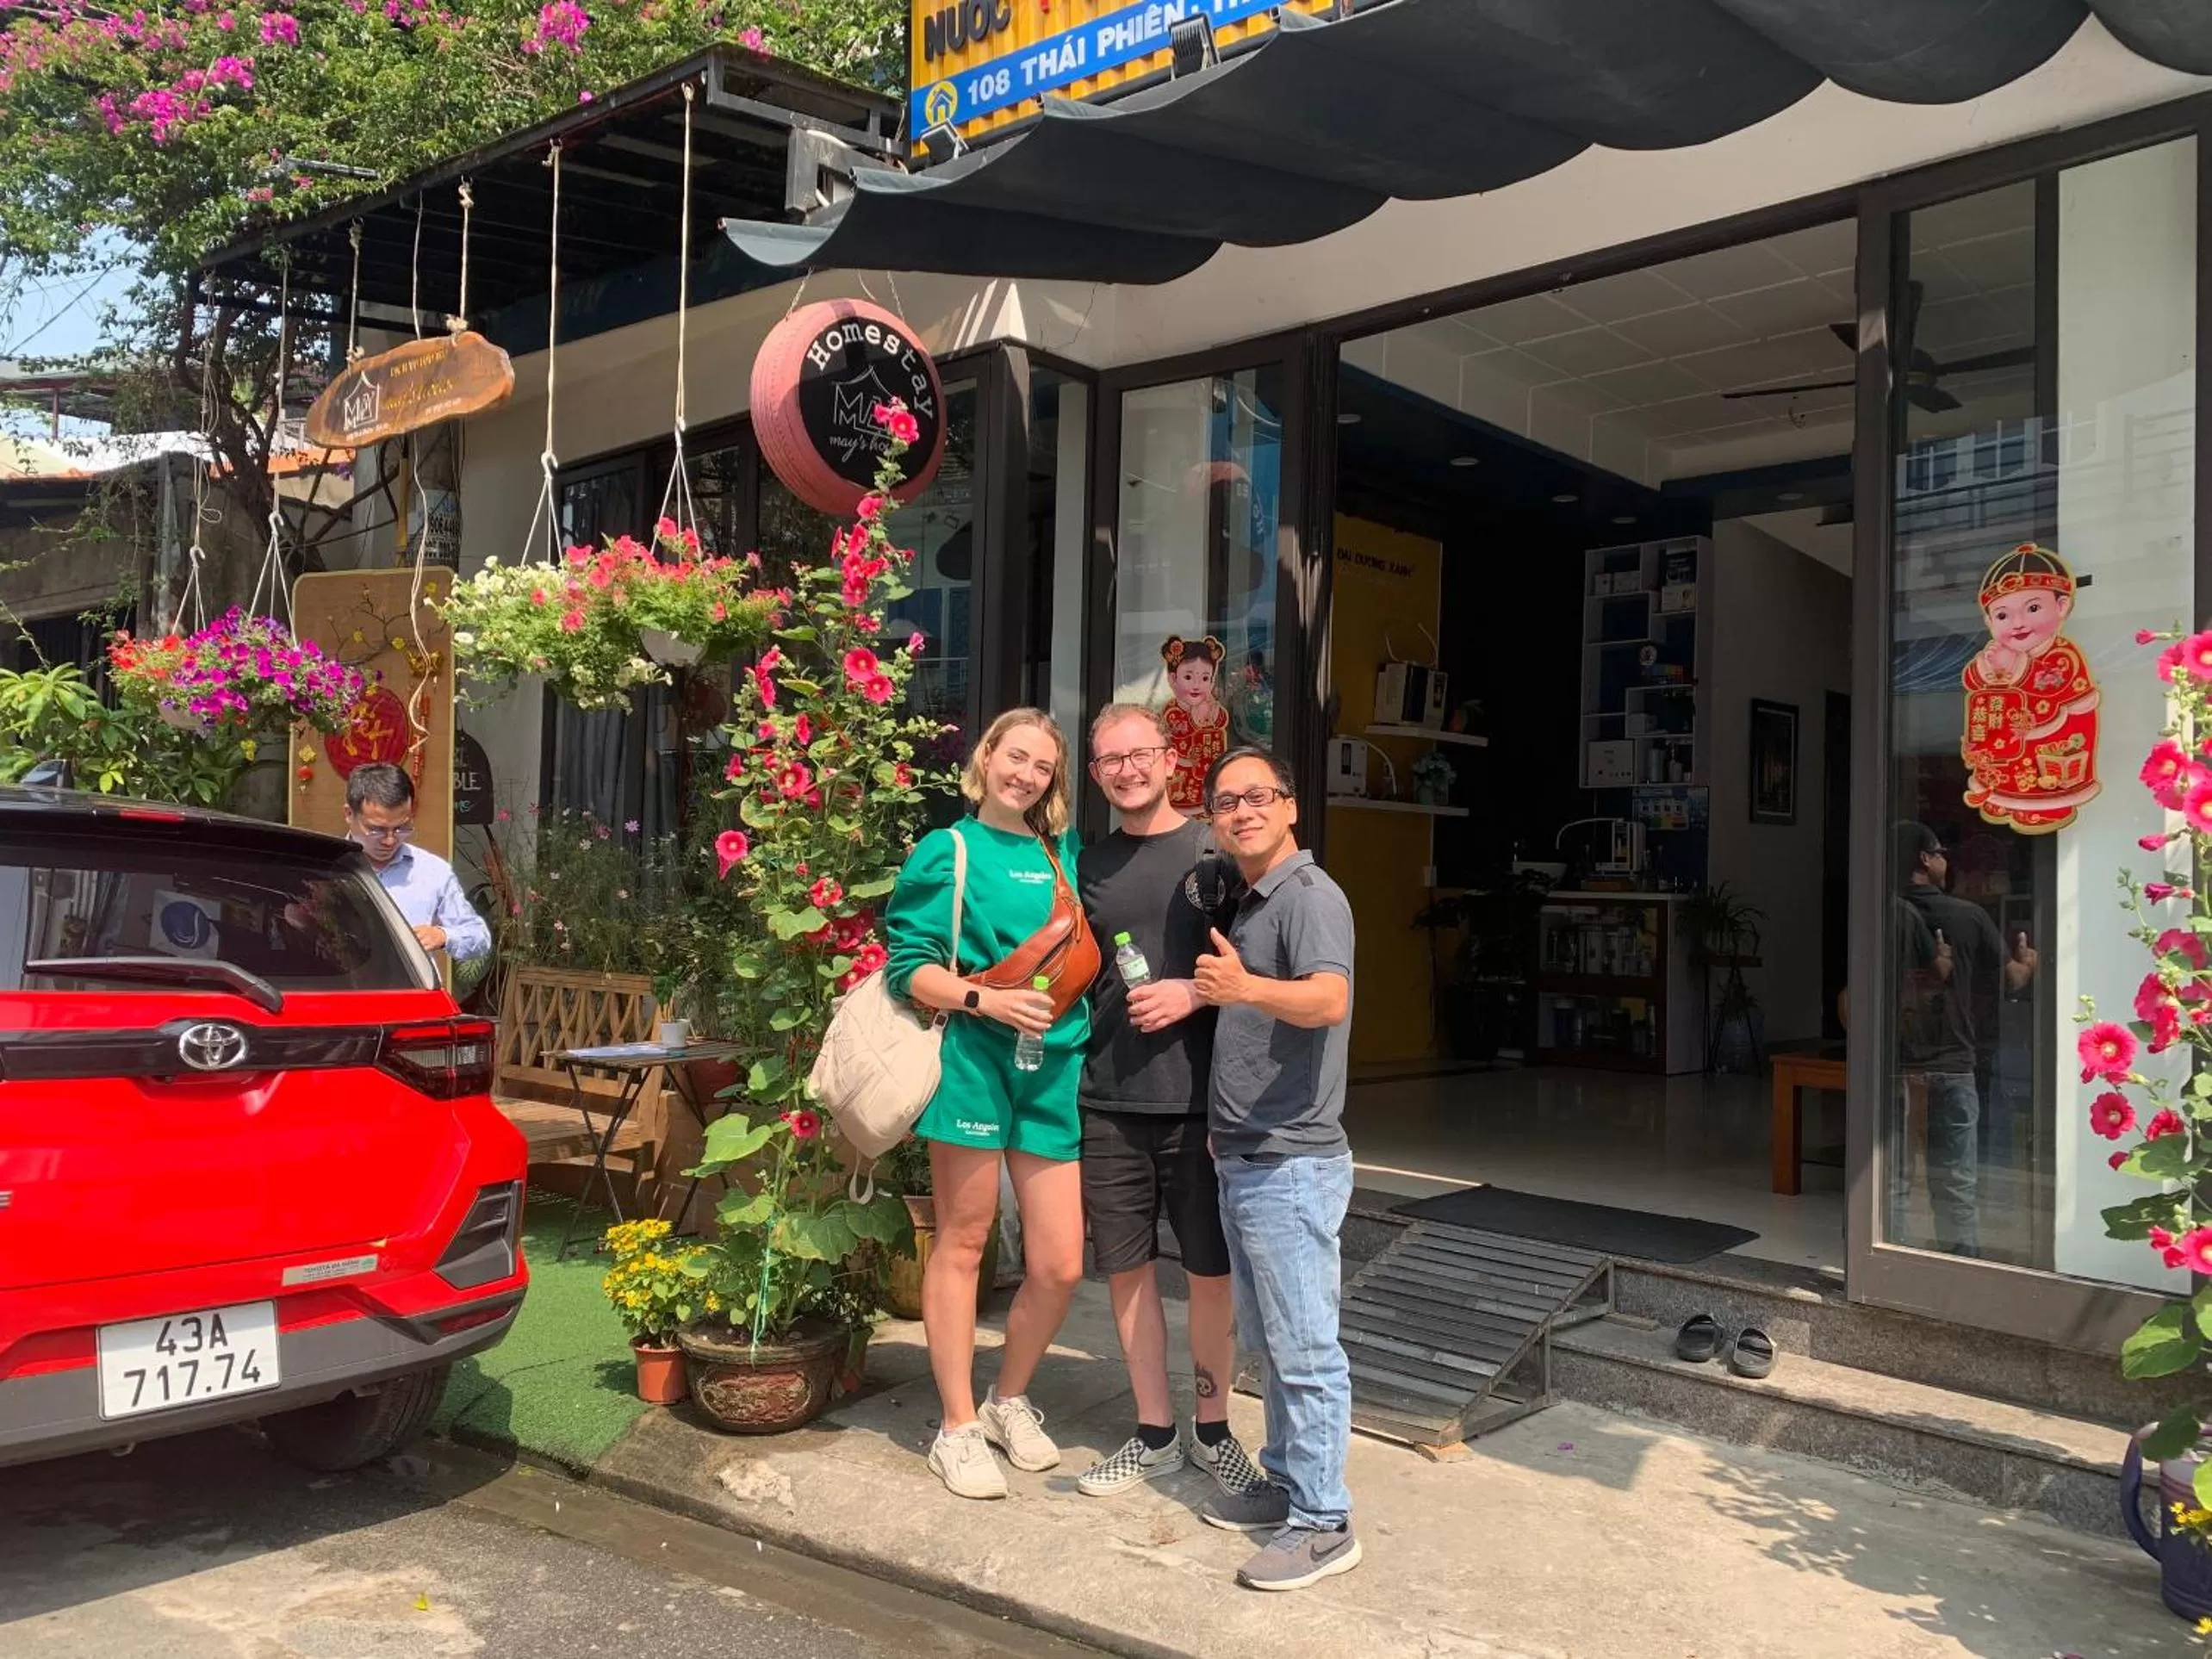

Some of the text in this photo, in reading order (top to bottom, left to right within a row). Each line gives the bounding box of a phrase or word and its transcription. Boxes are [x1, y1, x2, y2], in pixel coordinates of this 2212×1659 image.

[967, 0, 1184, 106] 108 THÁI PHIÊN
[807, 323, 933, 419] Homestay
[830, 434, 867, 463] may's
[156, 1313, 228, 1356] 43A
[123, 1348, 260, 1407] 717.74
